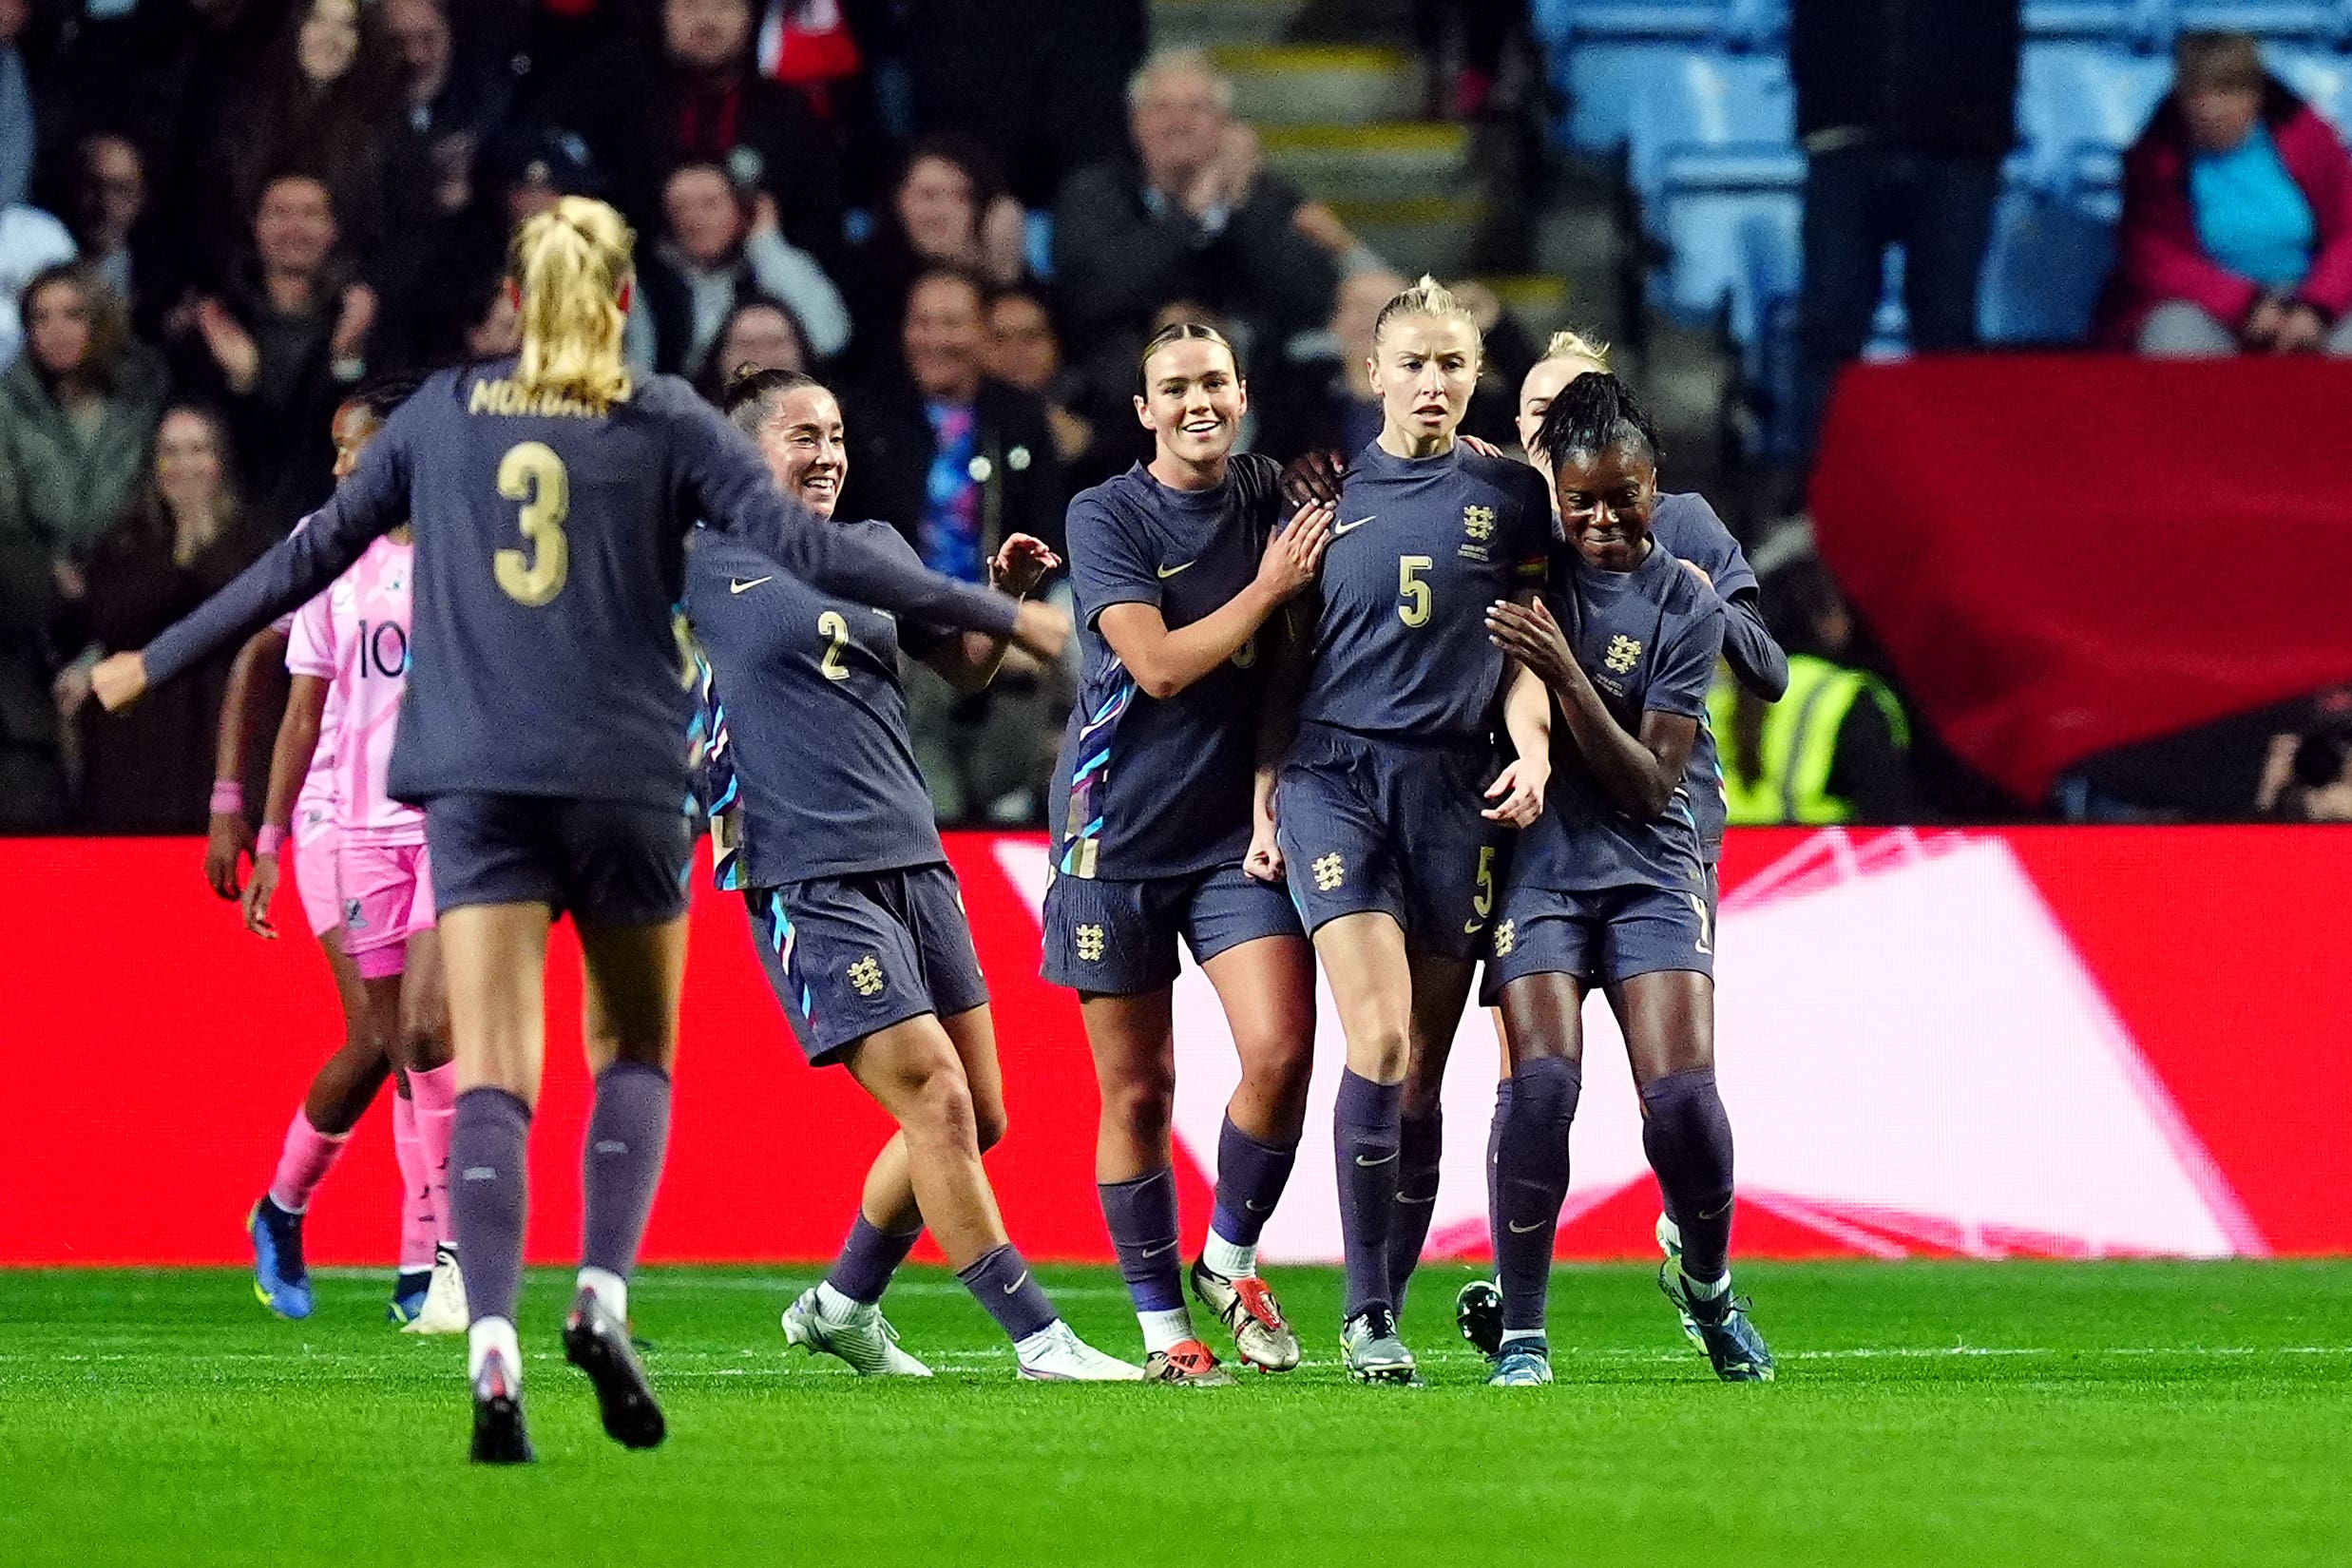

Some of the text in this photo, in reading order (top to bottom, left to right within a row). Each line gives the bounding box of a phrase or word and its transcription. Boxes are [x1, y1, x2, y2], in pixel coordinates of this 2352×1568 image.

[493, 440, 570, 607] 3
[1398, 555, 1433, 628] 5
[359, 619, 407, 679] 10
[817, 610, 851, 680] 2
[1473, 846, 1496, 919] 5
